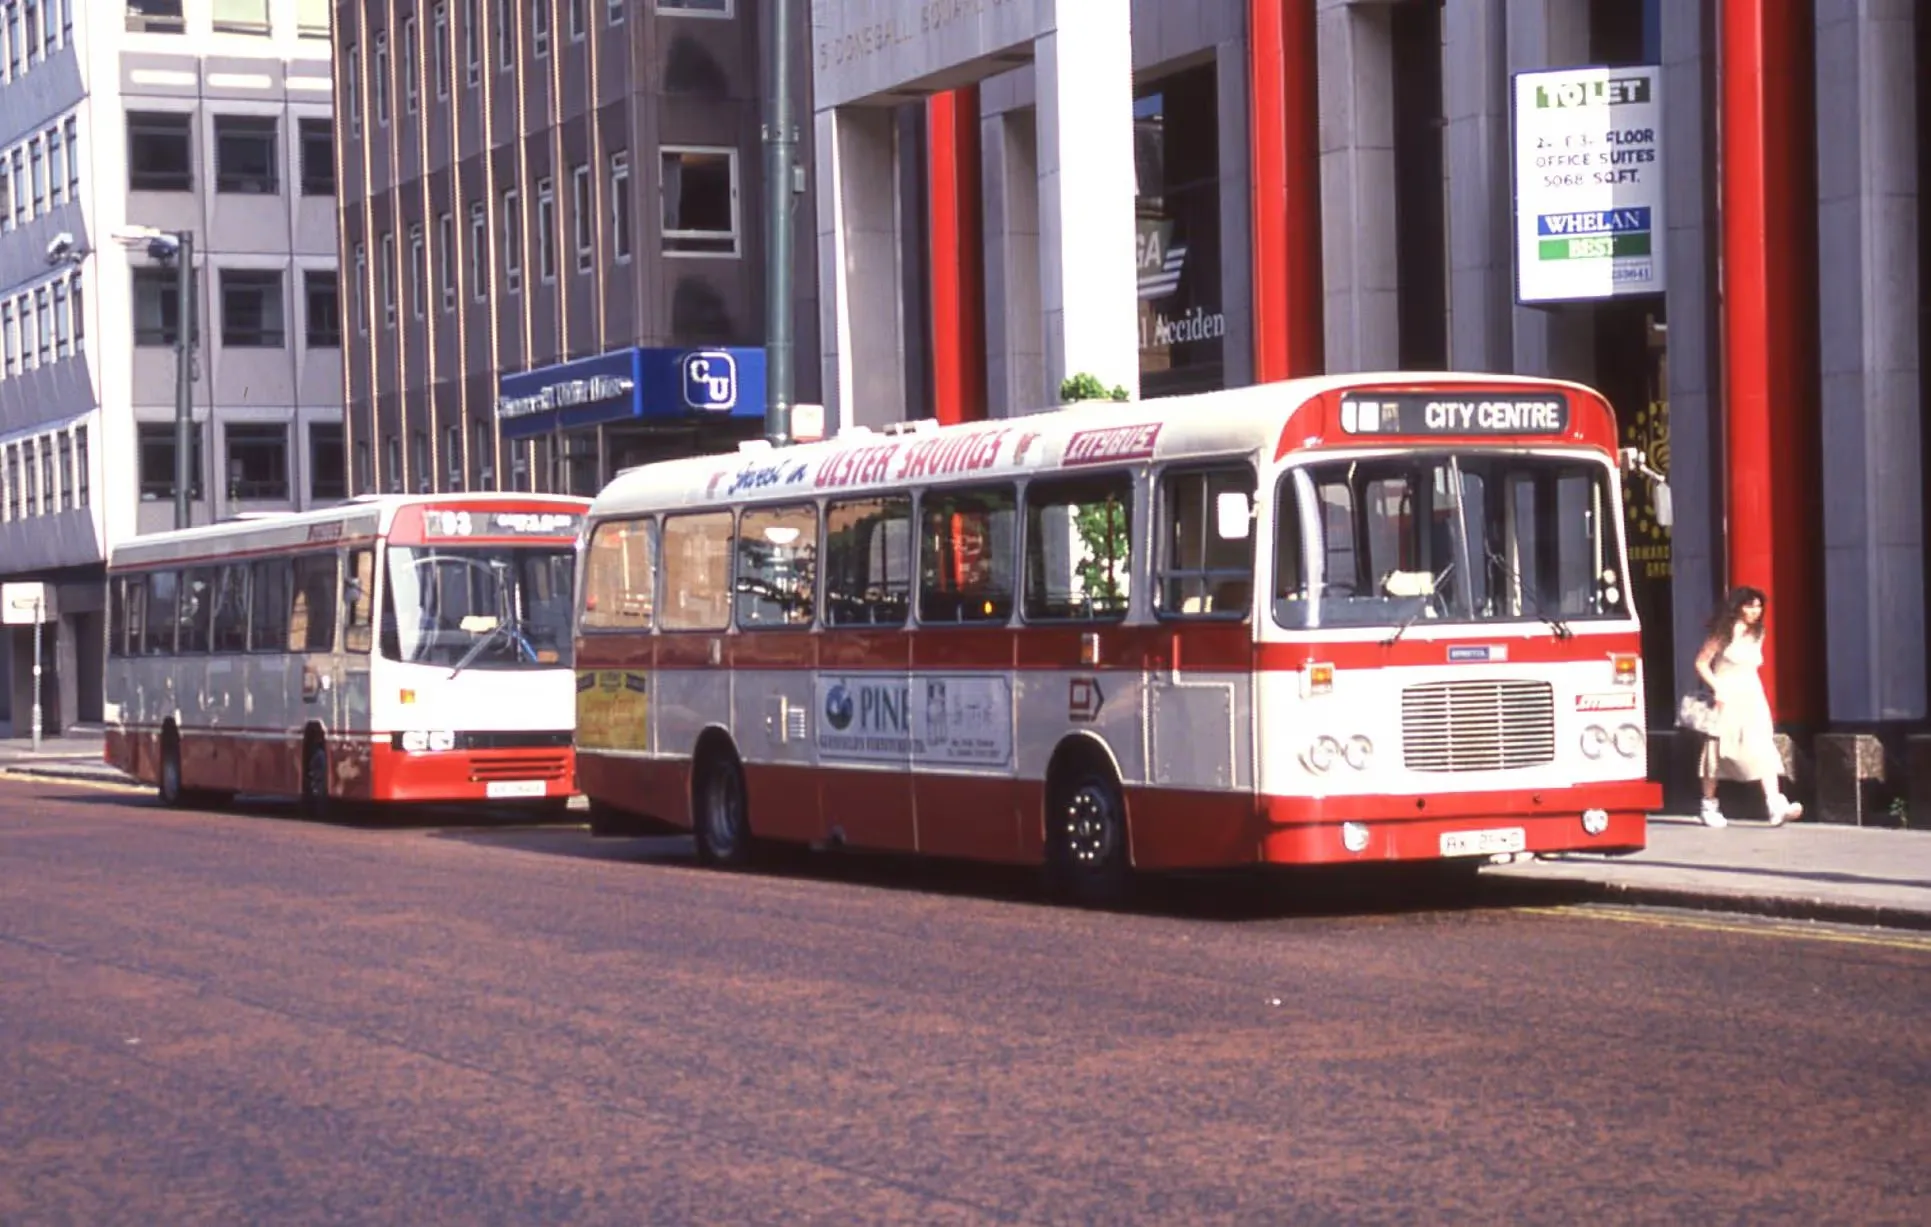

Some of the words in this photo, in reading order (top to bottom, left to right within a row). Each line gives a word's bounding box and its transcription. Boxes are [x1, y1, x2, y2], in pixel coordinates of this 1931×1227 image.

[1606, 128, 1654, 145] FLOOR
[1536, 153, 1590, 168] OFFICE
[1600, 148, 1656, 164] SUITES
[1544, 211, 1640, 234] WHELAN
[1425, 402, 1476, 428] CITY
[1477, 401, 1560, 429] CENTRE
[814, 443, 900, 489] ULSTER
[896, 428, 1014, 480] SAVINGS
[861, 685, 911, 733] PINE
